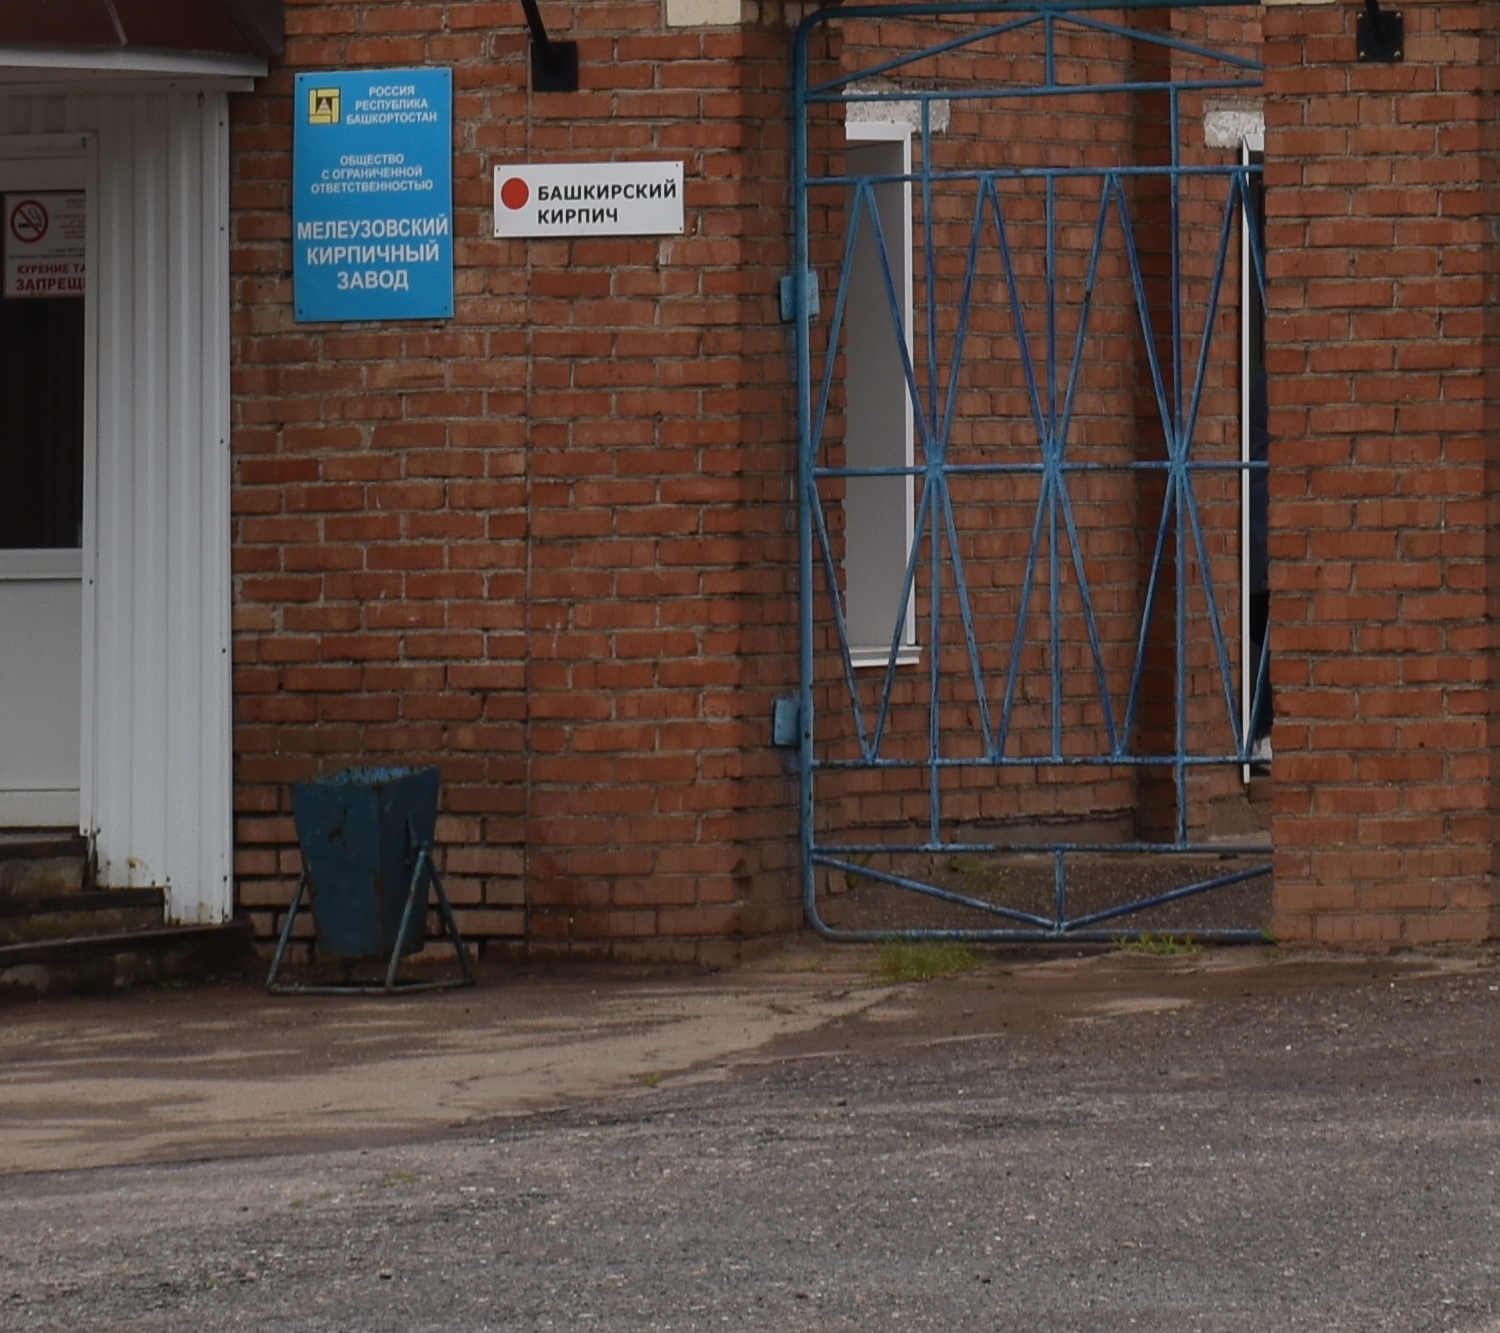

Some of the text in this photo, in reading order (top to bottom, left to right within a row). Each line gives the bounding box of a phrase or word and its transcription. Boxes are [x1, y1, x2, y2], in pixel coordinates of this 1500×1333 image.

[369, 85, 415, 97] РОССИЯ
[355, 98, 428, 111] РЕСПУБЛИКА
[346, 112, 437, 125] БАШКОРТОСТАН
[340, 153, 404, 166] ОБЩЕСТВО
[321, 166, 422, 180] С ОГРАНИЧЕННОЙ
[311, 180, 433, 194] ОТВЕТСТВЕННОСТЬЮ
[538, 178, 677, 201] БАШКИРСКИЙ
[538, 207, 618, 224] КИРПИЧ
[297, 213, 448, 240] МЕЛЕУЗОВСКИЙ
[307, 239, 439, 265] КИРПИЧНЫЙ
[17, 263, 69, 274] КУРЕНИЕ
[16, 278, 85, 292] ЗАПРЕЩ
[337, 270, 409, 291] ЗАВОД
